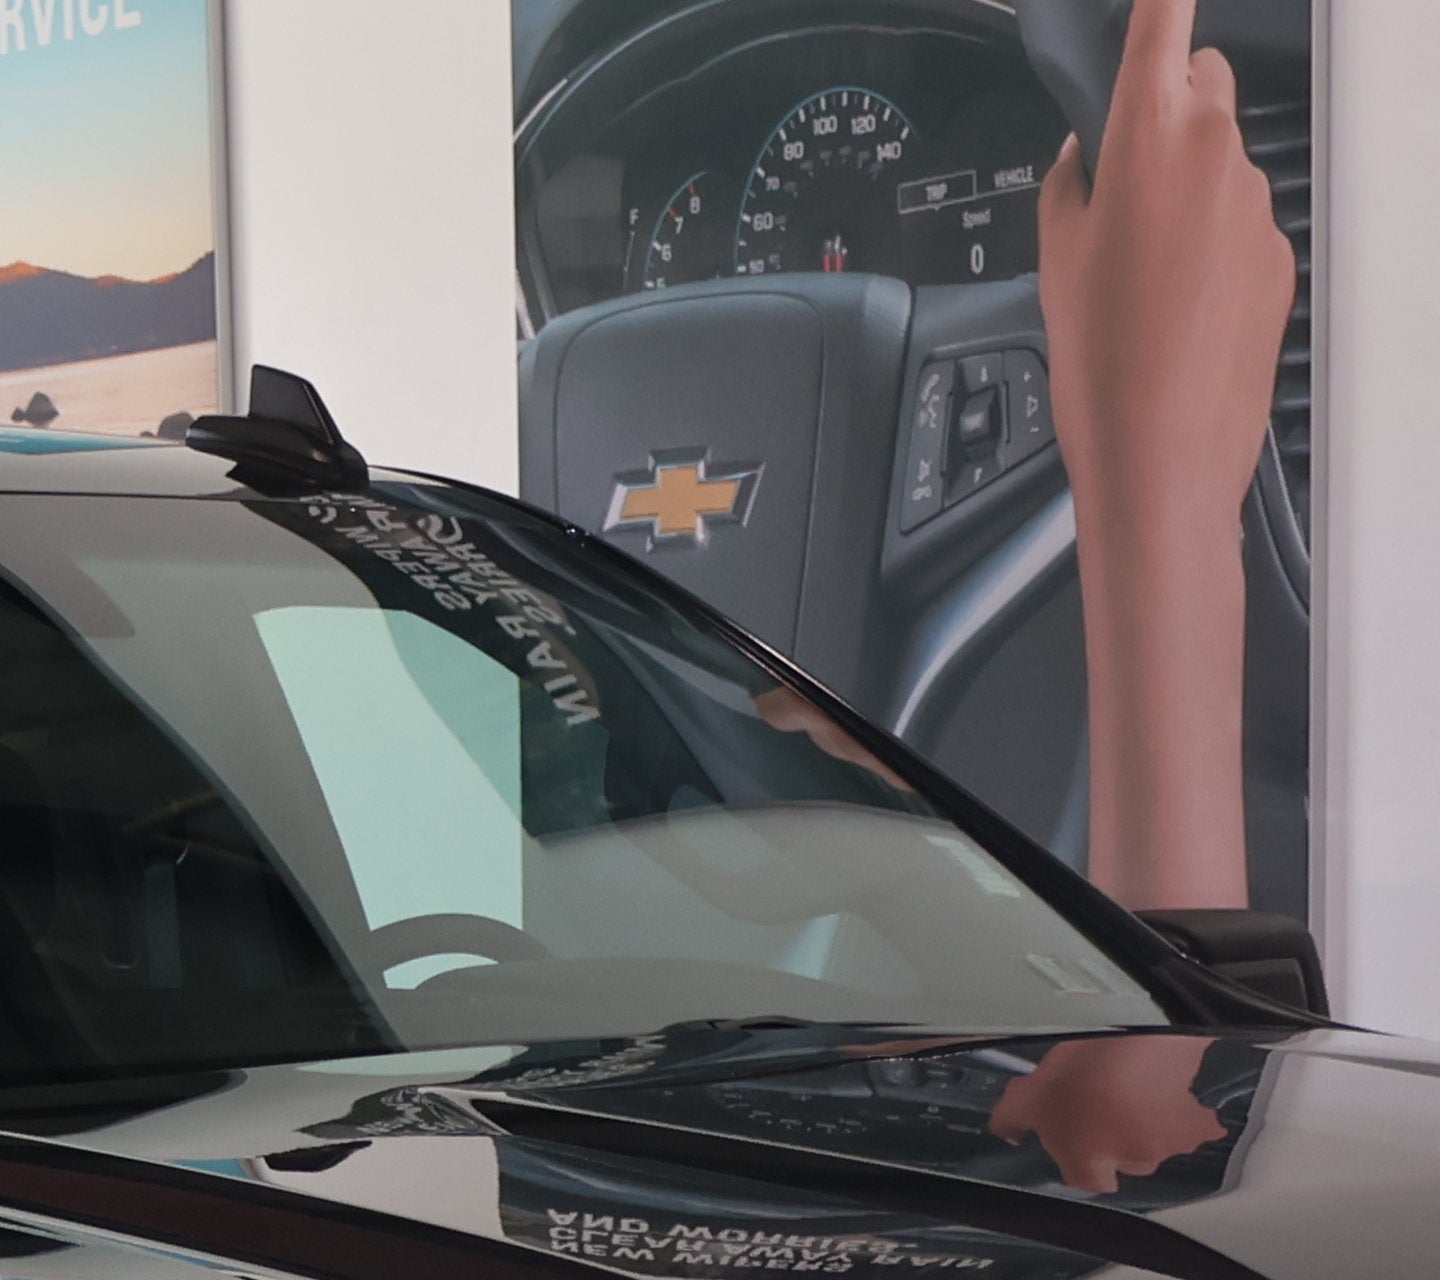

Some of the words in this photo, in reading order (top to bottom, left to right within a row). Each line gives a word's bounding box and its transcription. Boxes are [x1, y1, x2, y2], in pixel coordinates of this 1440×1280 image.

[812, 115, 837, 136] 100
[850, 114, 877, 135] 120
[782, 140, 805, 161] 80
